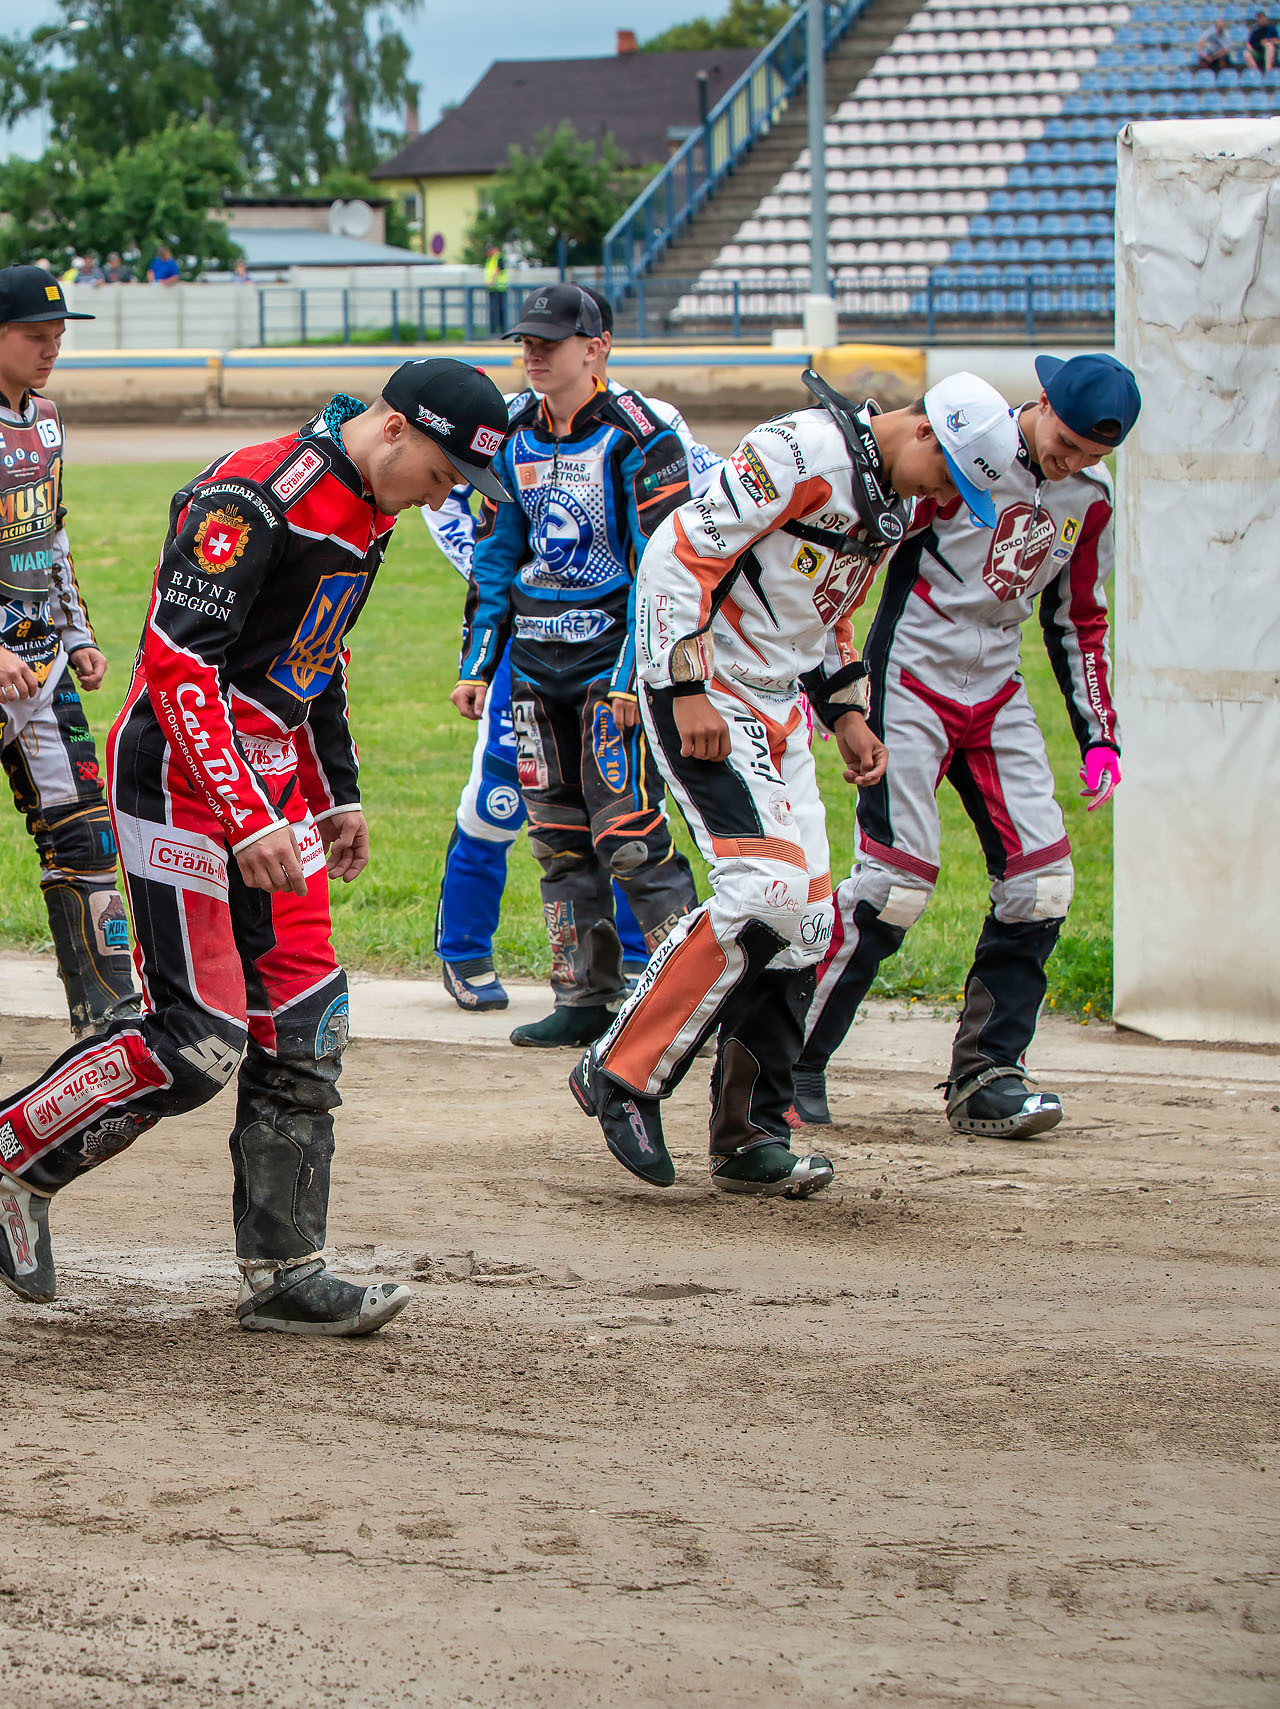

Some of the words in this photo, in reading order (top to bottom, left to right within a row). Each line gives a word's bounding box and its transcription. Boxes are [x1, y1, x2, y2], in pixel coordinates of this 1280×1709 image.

[39, 423, 58, 443] 15
[740, 476, 764, 500] CAMK
[694, 499, 727, 551] intergaz
[995, 523, 1051, 554] LOKOOTIV
[170, 571, 237, 603] RIVNE
[164, 588, 232, 622] REGION
[2, 1195, 34, 1266] TCX
